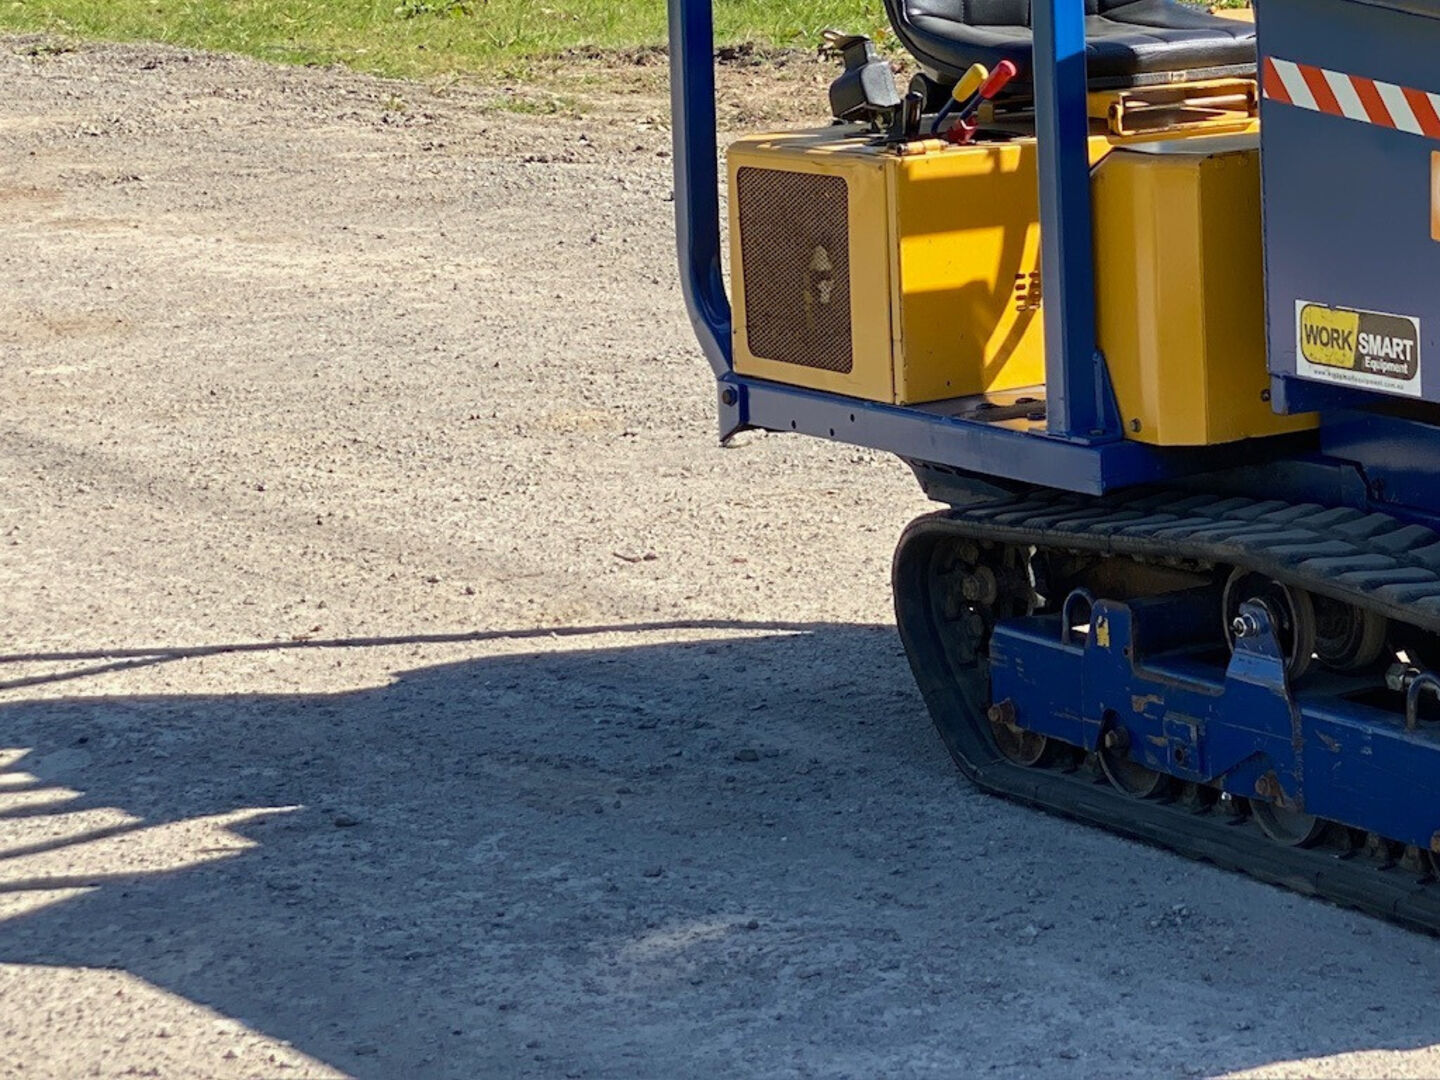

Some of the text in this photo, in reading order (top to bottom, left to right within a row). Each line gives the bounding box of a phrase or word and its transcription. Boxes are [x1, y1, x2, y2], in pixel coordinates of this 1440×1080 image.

[1304, 323, 1414, 361] WORK SMART
[1364, 356, 1408, 374] Equipment
